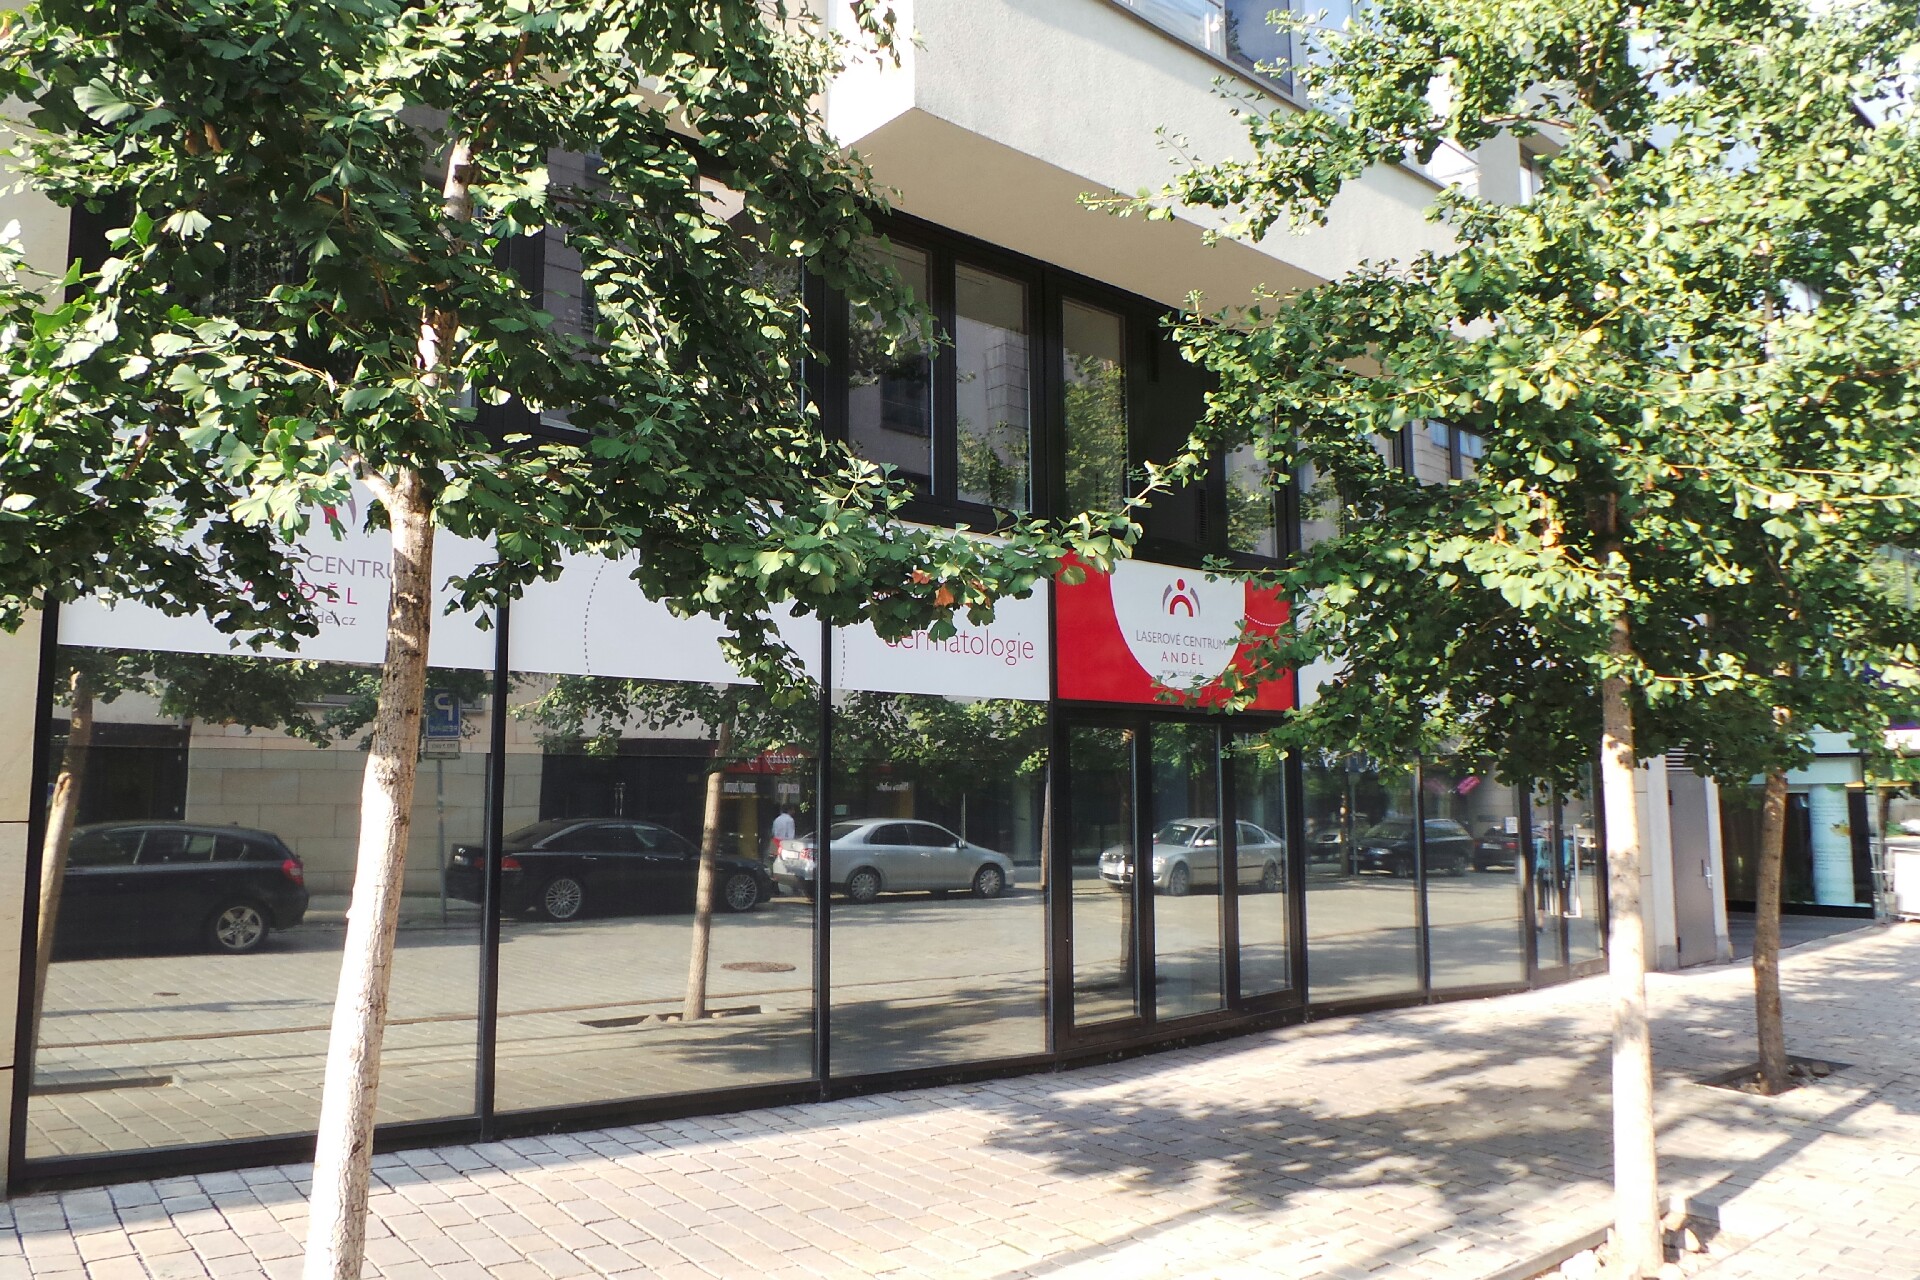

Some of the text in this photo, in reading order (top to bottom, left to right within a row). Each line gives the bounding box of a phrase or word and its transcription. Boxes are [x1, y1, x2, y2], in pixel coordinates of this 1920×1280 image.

[307, 554, 393, 580] CENTR
[240, 580, 358, 605] ADĚL
[884, 629, 1034, 666] ermatologie
[1135, 629, 1226, 651] LASEROVÉ CENTRUM
